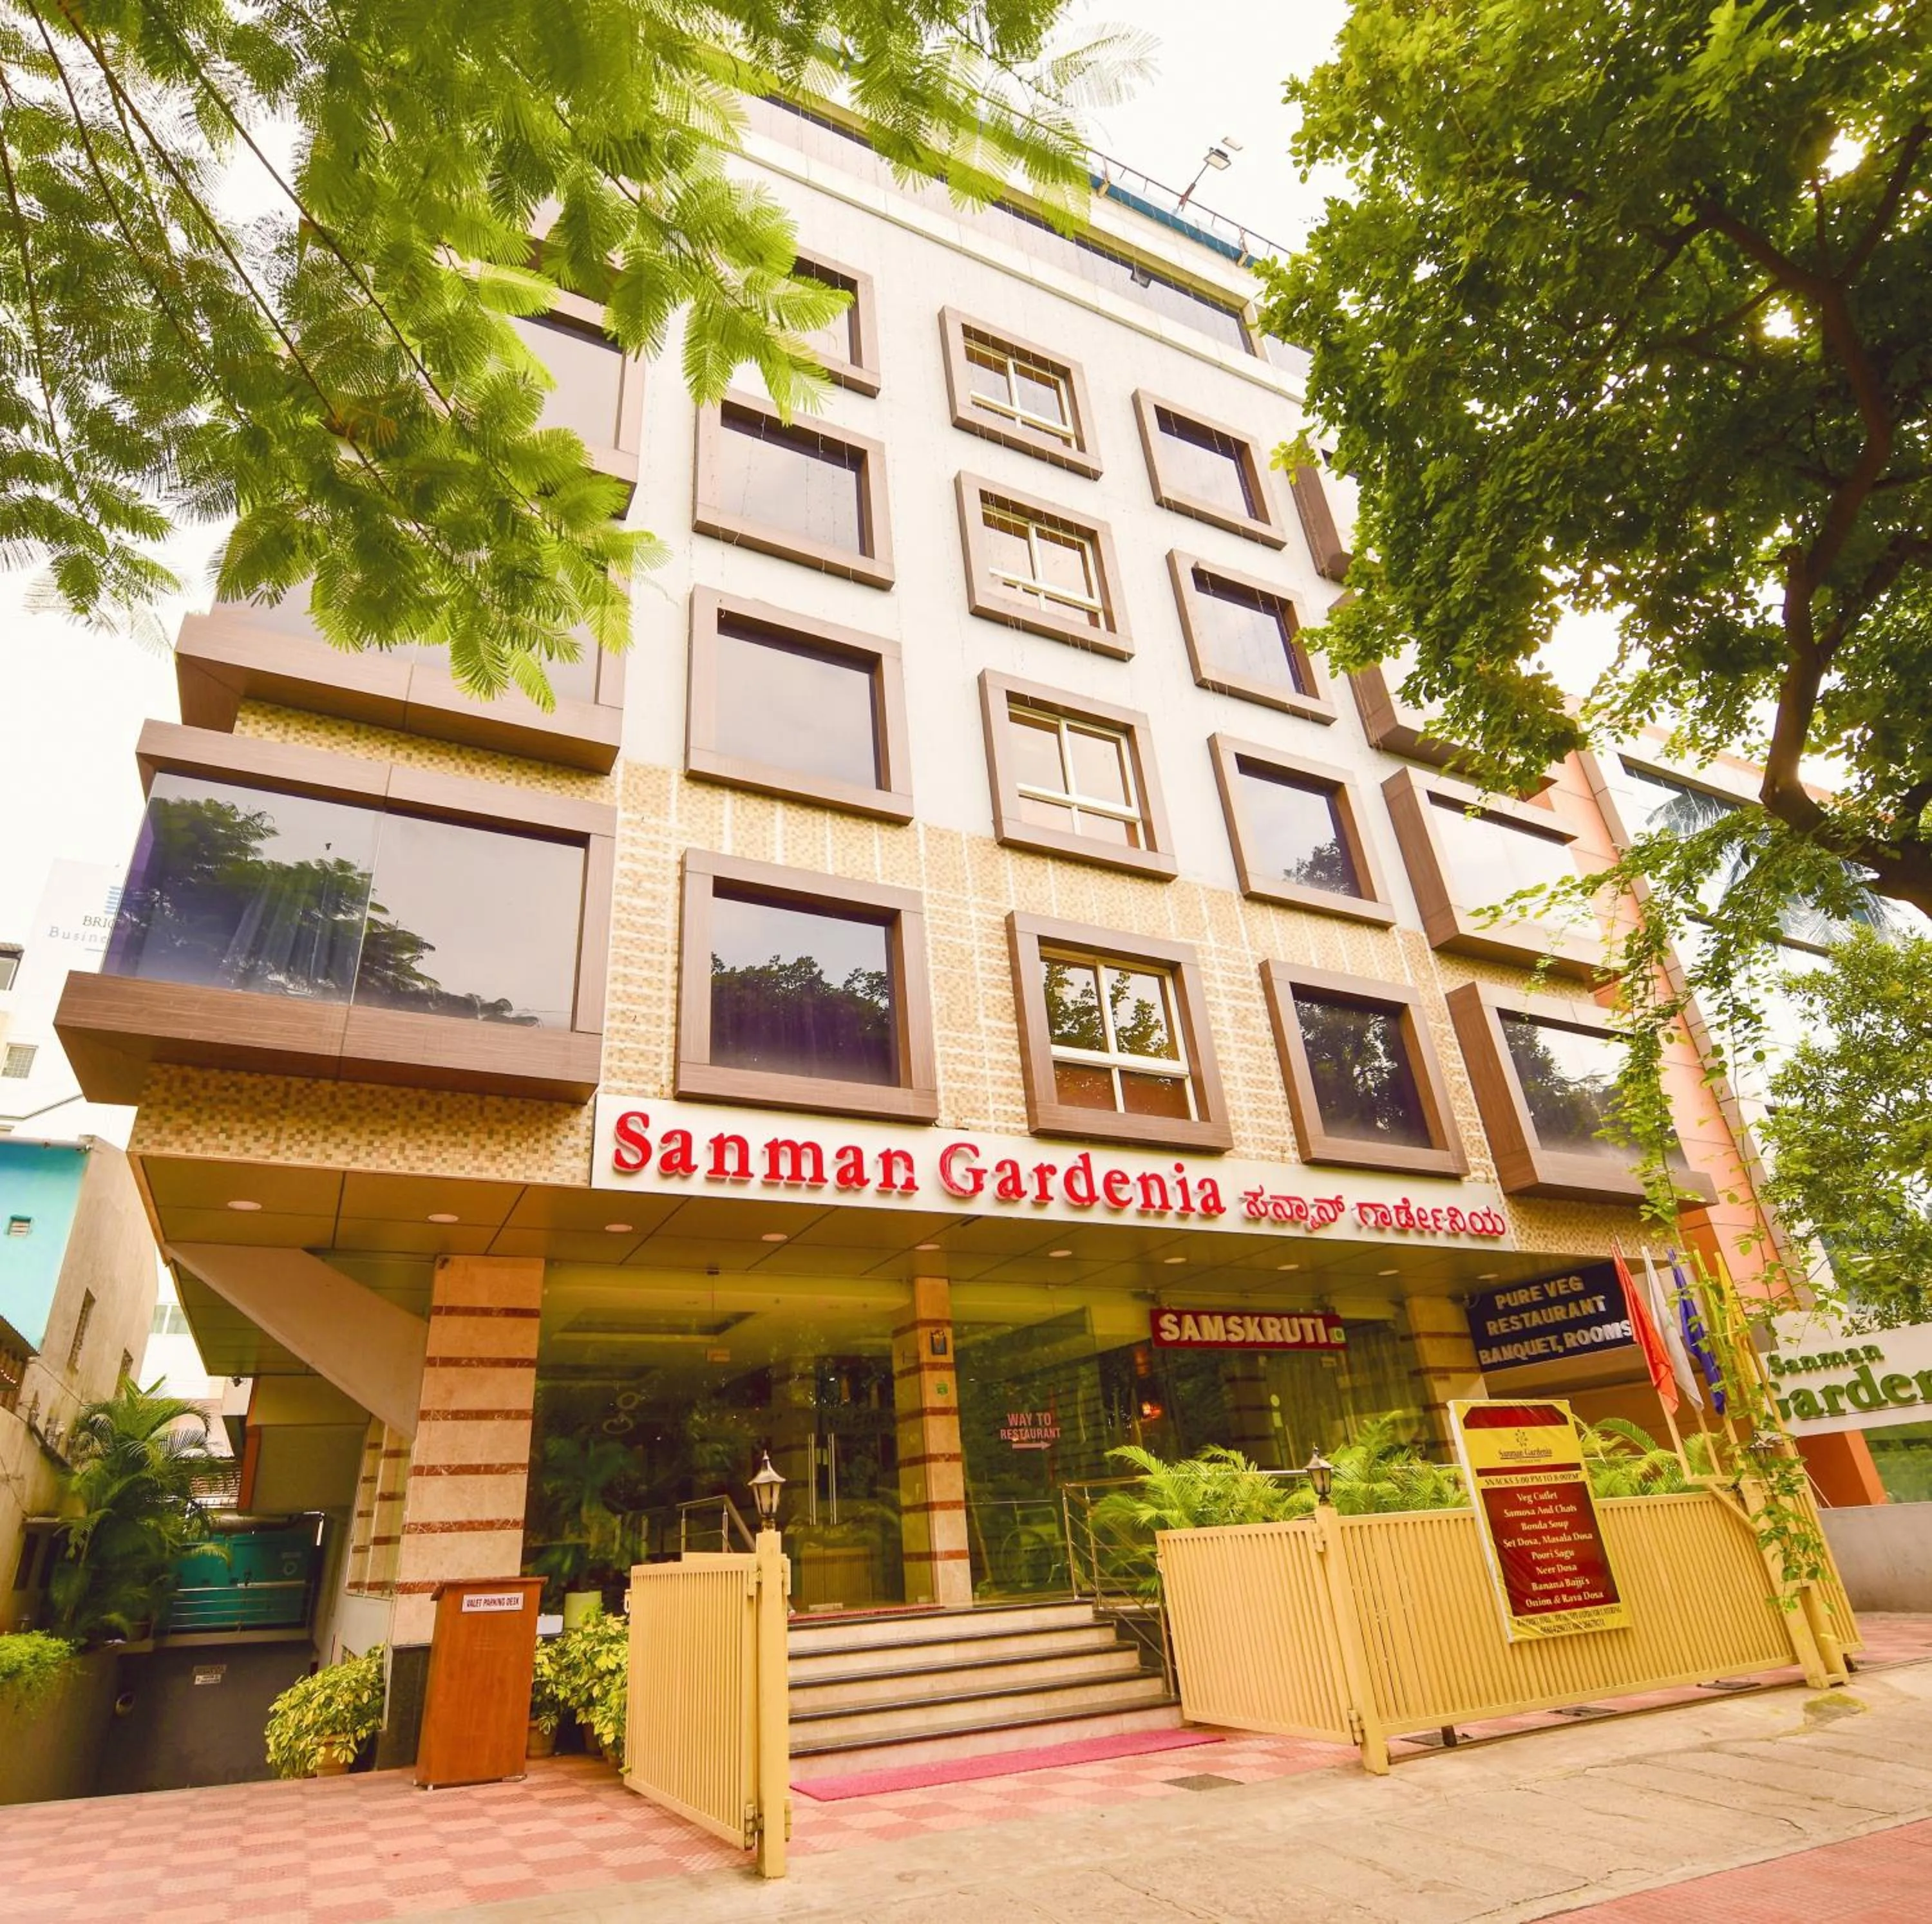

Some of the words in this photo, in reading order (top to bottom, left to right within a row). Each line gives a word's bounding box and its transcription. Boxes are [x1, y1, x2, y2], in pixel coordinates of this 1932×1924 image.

[612, 1111, 920, 1194] Sanman
[938, 1142, 1227, 1216] Gardenia
[1494, 1286, 1544, 1310] PURE
[1544, 1276, 1585, 1297] VEG
[1486, 1295, 1607, 1337] RESTAURANT
[1160, 1314, 1328, 1343] SAMSKRUTI
[1479, 1335, 1565, 1364] BANQUET,
[1563, 1319, 1633, 1348] ROOMS
[1766, 1344, 1884, 1376] Sanman
[1007, 1413, 1032, 1426] WAY
[1036, 1412, 1052, 1426] TO
[1000, 1427, 1061, 1440] RESTAURANT
[1517, 1494, 1533, 1504] Veg
[1533, 1491, 1558, 1501] Cutlet
[1504, 1509, 1536, 1518] Samosa
[1537, 1505, 1554, 1515] And
[1555, 1504, 1577, 1514] Chats
[1521, 1520, 1547, 1531] Bonda
[1548, 1520, 1569, 1530] Soup
[1503, 1539, 1516, 1549] Set
[1517, 1538, 1541, 1546] Dosa,
[1542, 1533, 1572, 1543] Masala
[1531, 1550, 1554, 1560] Poori
[1554, 1550, 1575, 1560] Sagu
[1556, 1564, 1577, 1572] Dosa
[1531, 1582, 1564, 1591] Banana
[466, 1599, 482, 1608] VALET
[483, 1598, 505, 1607] PARKING
[1526, 1598, 1552, 1608] Onion
[1553, 1595, 1561, 1604] &
[1561, 1594, 1582, 1603] Rava
[1582, 1591, 1604, 1600] Dosa
